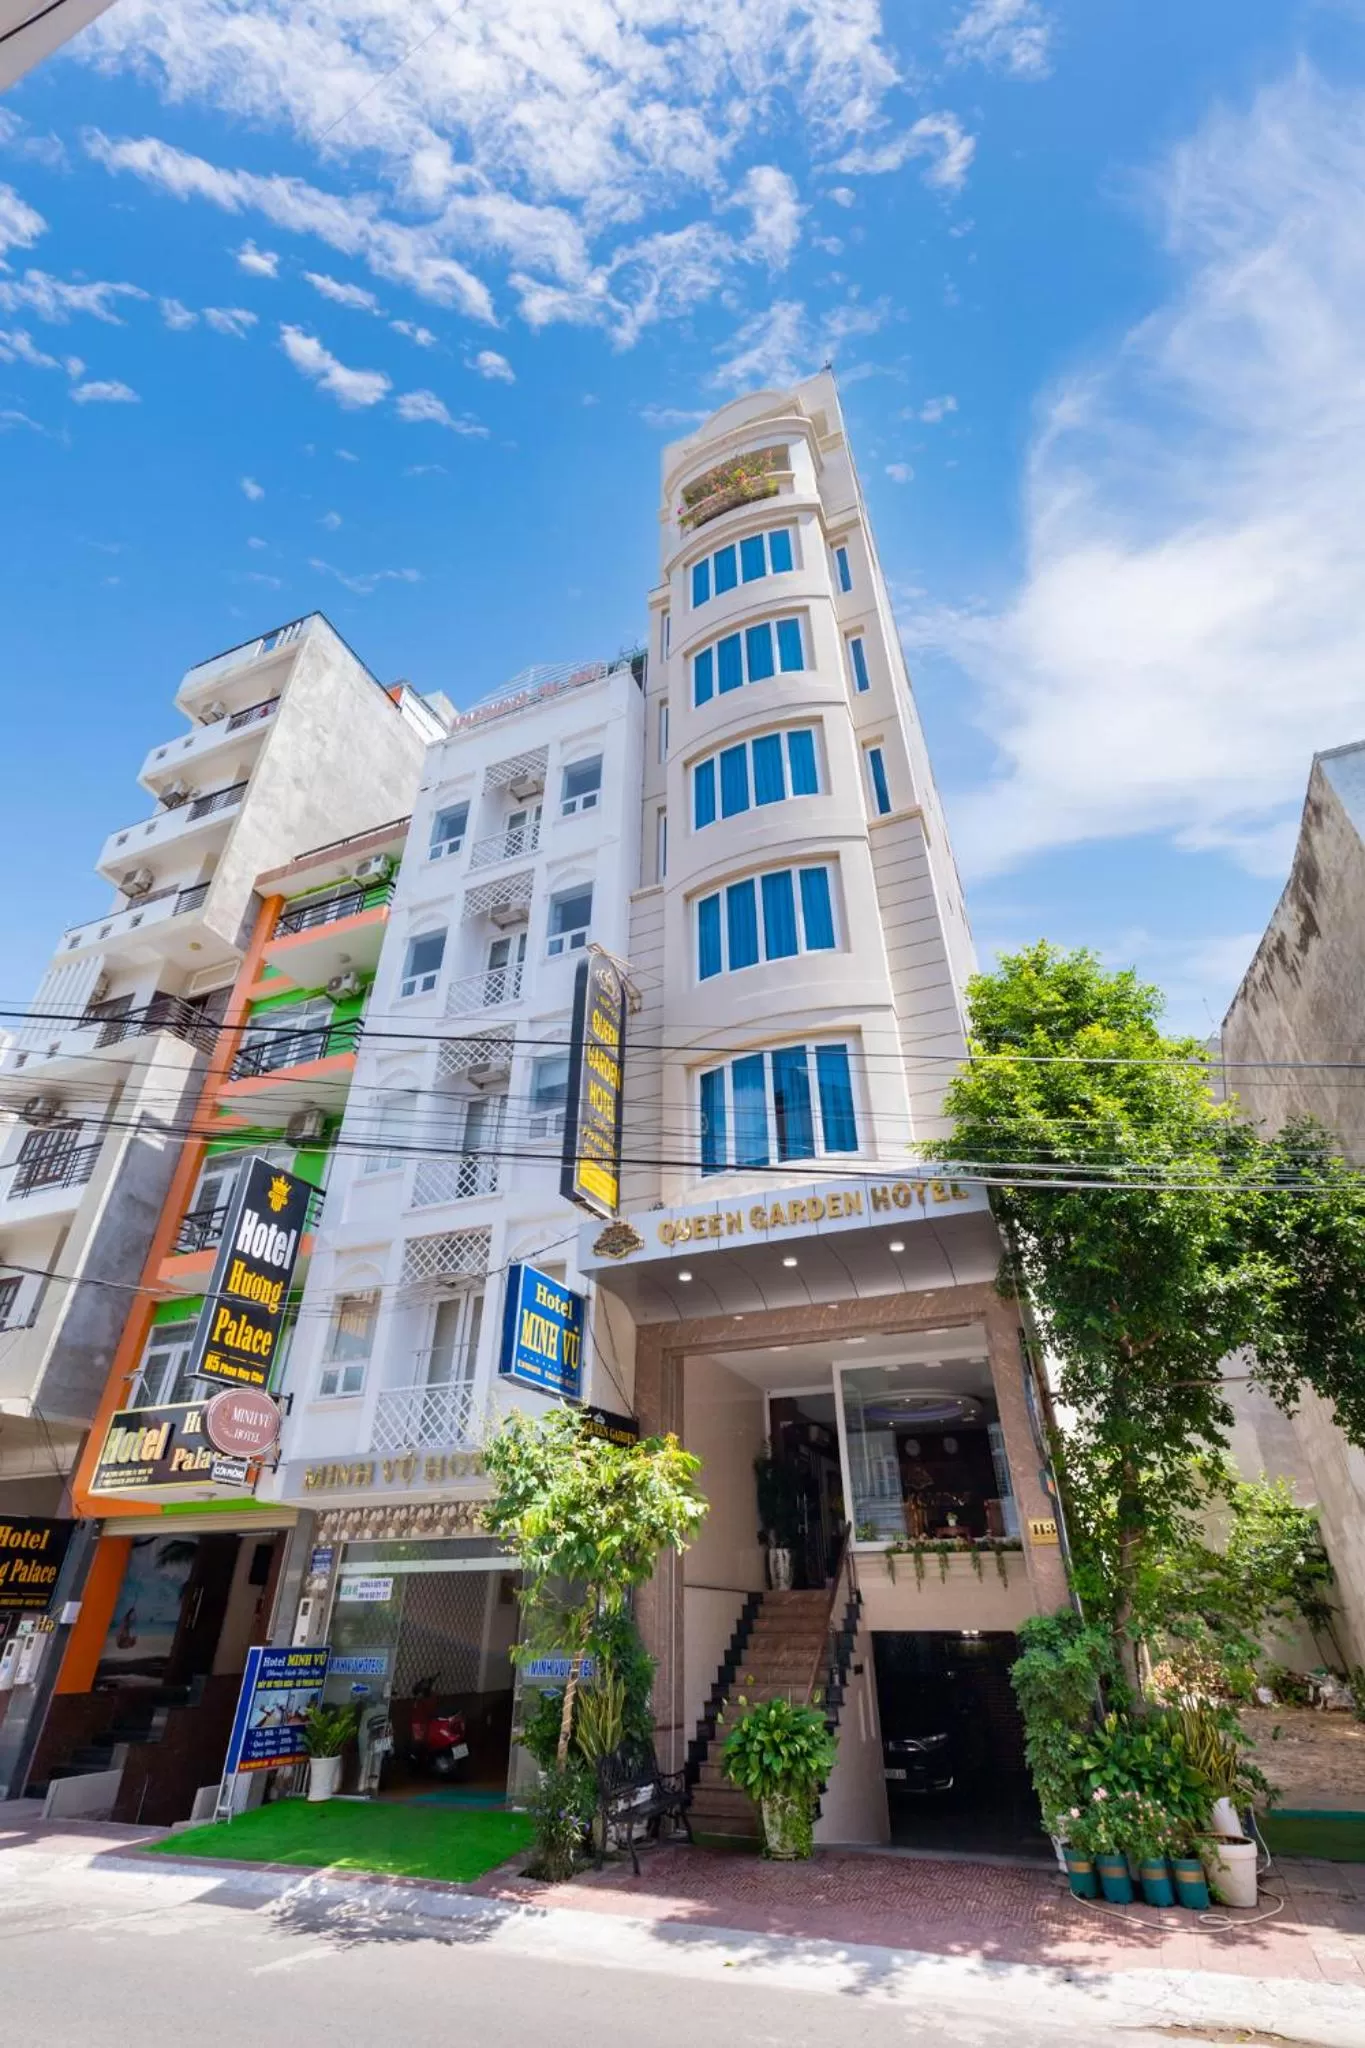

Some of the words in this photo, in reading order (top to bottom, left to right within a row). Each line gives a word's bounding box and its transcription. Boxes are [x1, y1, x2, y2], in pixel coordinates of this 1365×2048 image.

[592, 1008, 620, 1055] QUEEN
[588, 1079, 616, 1124] HOTEL
[658, 1210, 743, 1247] QUEEN
[750, 1190, 863, 1230] GARDEN
[870, 1179, 971, 1213] HOTEL
[235, 1208, 297, 1270] Hotel
[535, 1282, 573, 1320] Hotel
[212, 1307, 272, 1356] Palace
[520, 1308, 560, 1361] MINH
[234, 1406, 257, 1425] MINH
[101, 1422, 172, 1465] Hotel
[304, 1462, 374, 1490] MINH
[0, 1525, 50, 1549] Hotel
[8, 1559, 57, 1583] Palace
[263, 1657, 286, 1668] Hotel
[287, 1655, 312, 1667] MINH
